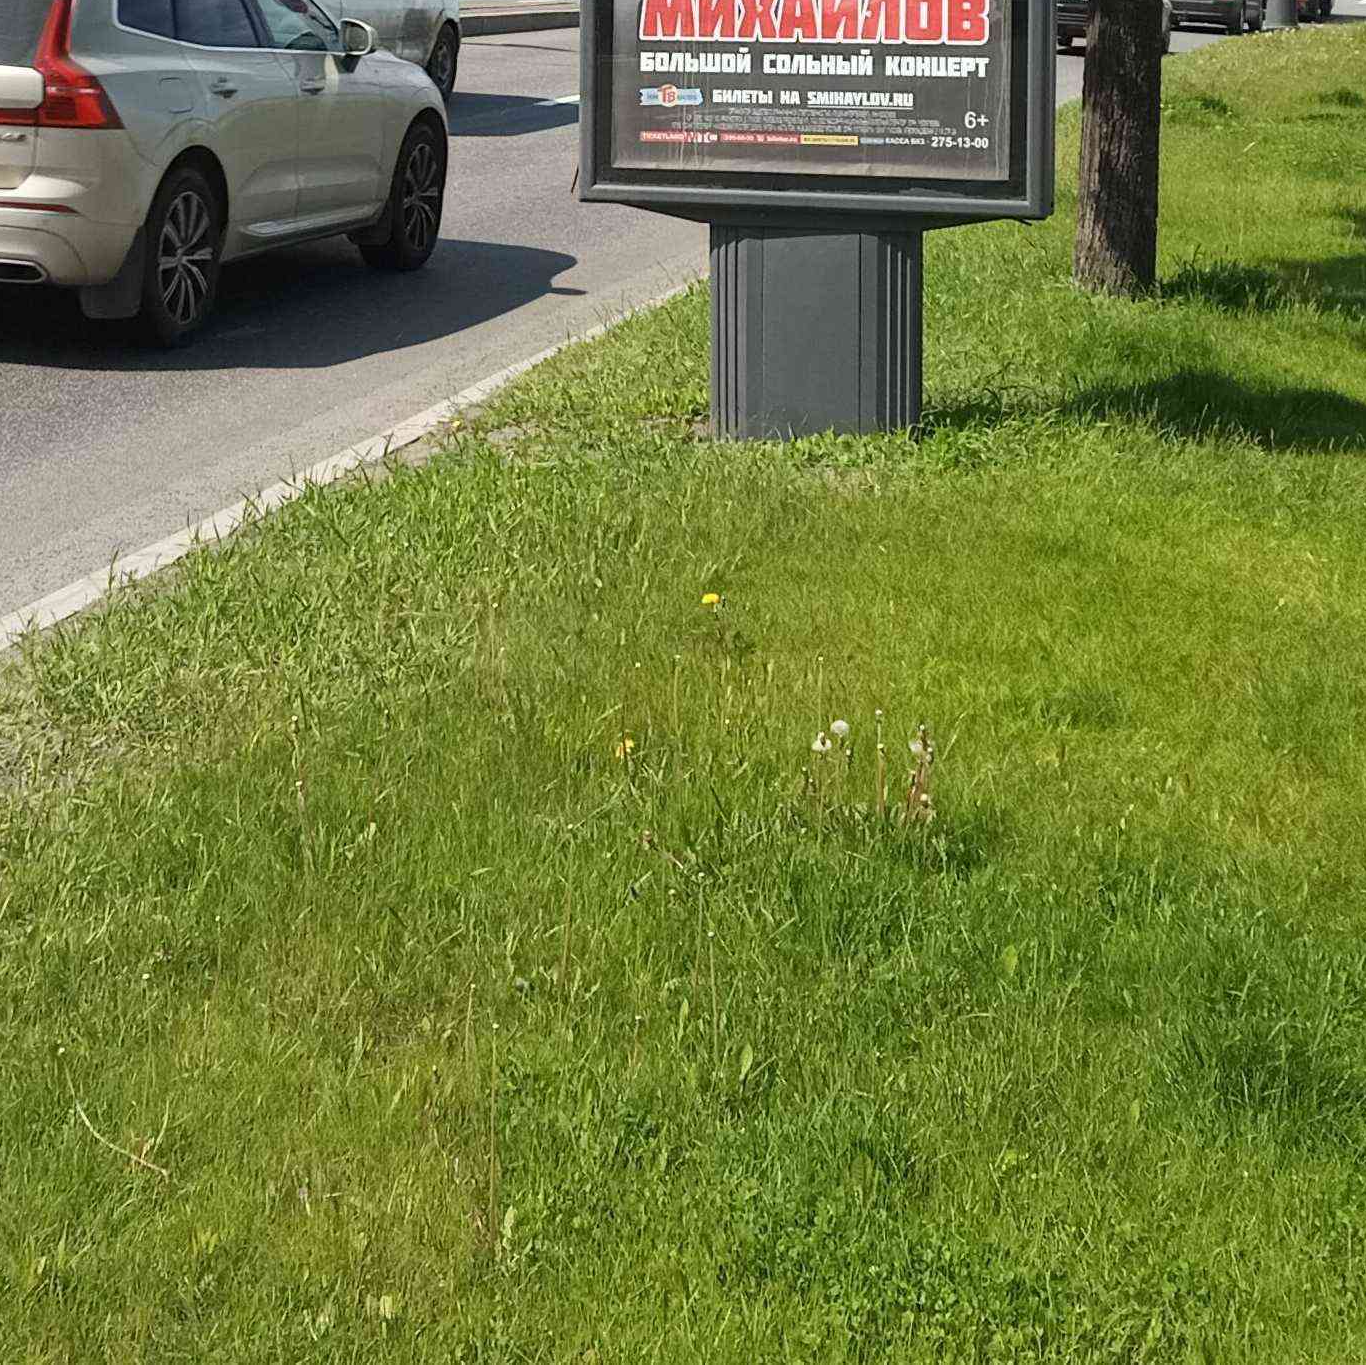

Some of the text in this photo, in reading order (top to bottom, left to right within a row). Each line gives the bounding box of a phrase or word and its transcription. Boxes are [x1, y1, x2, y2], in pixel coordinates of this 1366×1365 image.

[640, 46, 990, 78] БОЛЬШОЙ СОЛЬНЫЙ КОНЦЕРТ
[712, 89, 773, 104] БИЛЕТЫ
[780, 91, 801, 105] НА
[807, 91, 914, 107] SMIHAYLOV.RU
[964, 111, 989, 129] 6+
[931, 136, 989, 149] 275-13-00
